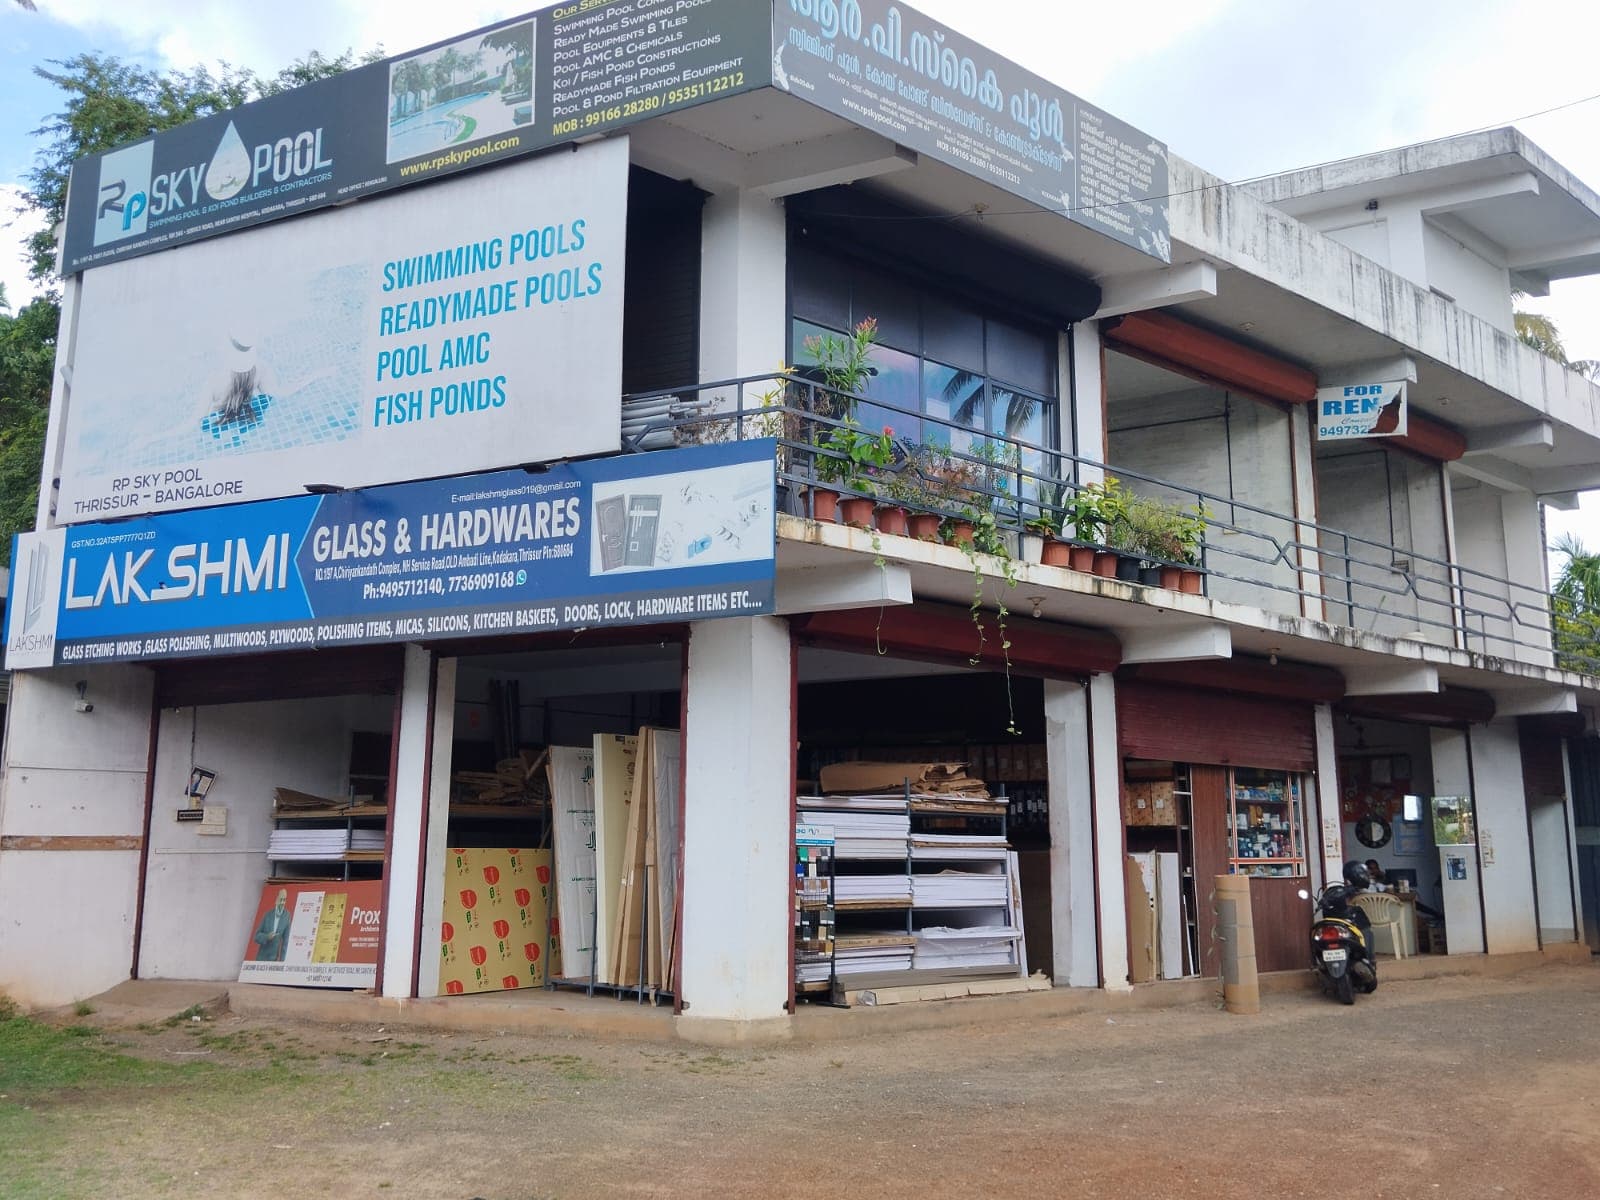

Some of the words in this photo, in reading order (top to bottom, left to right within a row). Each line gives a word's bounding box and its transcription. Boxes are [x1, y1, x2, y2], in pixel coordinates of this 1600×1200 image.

[553, 5, 577, 19] OUR
[553, 13, 604, 35] SWIMMING
[606, 5, 635, 19] POOL
[554, 32, 587, 49] READY
[588, 22, 619, 39] MADE
[620, 6, 674, 28] SWIMMING
[553, 49, 581, 63] POOL
[583, 28, 645, 54] EQUIPMENTS
[647, 23, 657, 34] &
[659, 15, 688, 31] TILES
[553, 63, 581, 77] POOL
[582, 49, 613, 68] AMC
[614, 46, 624, 58] &
[626, 31, 683, 54] CHEMICALS
[553, 78, 571, 91] KOI
[581, 68, 604, 82] FISH
[605, 60, 635, 75] POND
[637, 34, 721, 65] CONSTRUCTIONS
[553, 80, 612, 104] READYMADE
[614, 73, 638, 87] FISH
[640, 62, 676, 79] PONDS
[553, 104, 581, 118] POOL
[583, 98, 592, 109] &
[594, 91, 624, 106] POND
[625, 75, 680, 97] FILTRATION
[682, 57, 743, 81] EQUIPMENT
[553, 118, 578, 136] MOB
[586, 105, 621, 127] 99166
[623, 95, 659, 117] 28280
[668, 71, 744, 104] 9535112212
[150, 162, 206, 215] SKY
[252, 127, 333, 187] POOL
[400, 135, 520, 177] www.rpskypool.com
[149, 213, 182, 229] SWIMMING
[182, 209, 201, 220] POOL
[219, 198, 240, 209] POND
[239, 188, 273, 204] BUILDERS
[279, 171, 333, 193] CONTRACTORS
[382, 238, 503, 292] SWIMMING
[509, 218, 586, 265] POOLS
[379, 279, 519, 337] READYMADE
[525, 262, 602, 308] POOLS
[376, 343, 433, 382] POOL
[439, 331, 490, 371] AMC
[374, 390, 423, 428] FISH
[429, 375, 507, 418] PONDS
[1322, 397, 1379, 416] REN
[1343, 384, 1383, 397] FOR
[1320, 425, 1371, 437] 949732
[74, 493, 139, 515] THRISSUR
[155, 480, 243, 504] BANGALORE
[112, 478, 130, 492] RP
[134, 473, 161, 489] SKY
[164, 468, 203, 485] POOL
[313, 517, 386, 562] GLASS
[394, 516, 412, 555] &
[420, 496, 580, 552] HARDWARES
[363, 577, 446, 600] Ph:9495712140,
[448, 570, 514, 593] 7736909168
[411, 557, 431, 572] Service
[62, 645, 84, 660] GLASS
[84, 642, 115, 658] ETCHING
[116, 641, 142, 656] WORKS
[169, 635, 213, 652] POLISHING,
[213, 630, 268, 649] MULTIWOODS,
[269, 626, 315, 645] PLYWOODS,
[317, 622, 364, 640] POLISHING
[366, 620, 394, 638] ITEMS,
[395, 617, 425, 635] MICAS,
[427, 614, 471, 632] SILICONS,
[473, 611, 514, 630] KITCHEN
[515, 607, 559, 626] BASKETS,
[564, 603, 602, 623] DOORS,
[604, 600, 634, 620] LOCK,
[636, 595, 694, 617] HARDWARE
[696, 592, 728, 612] ITEMS
